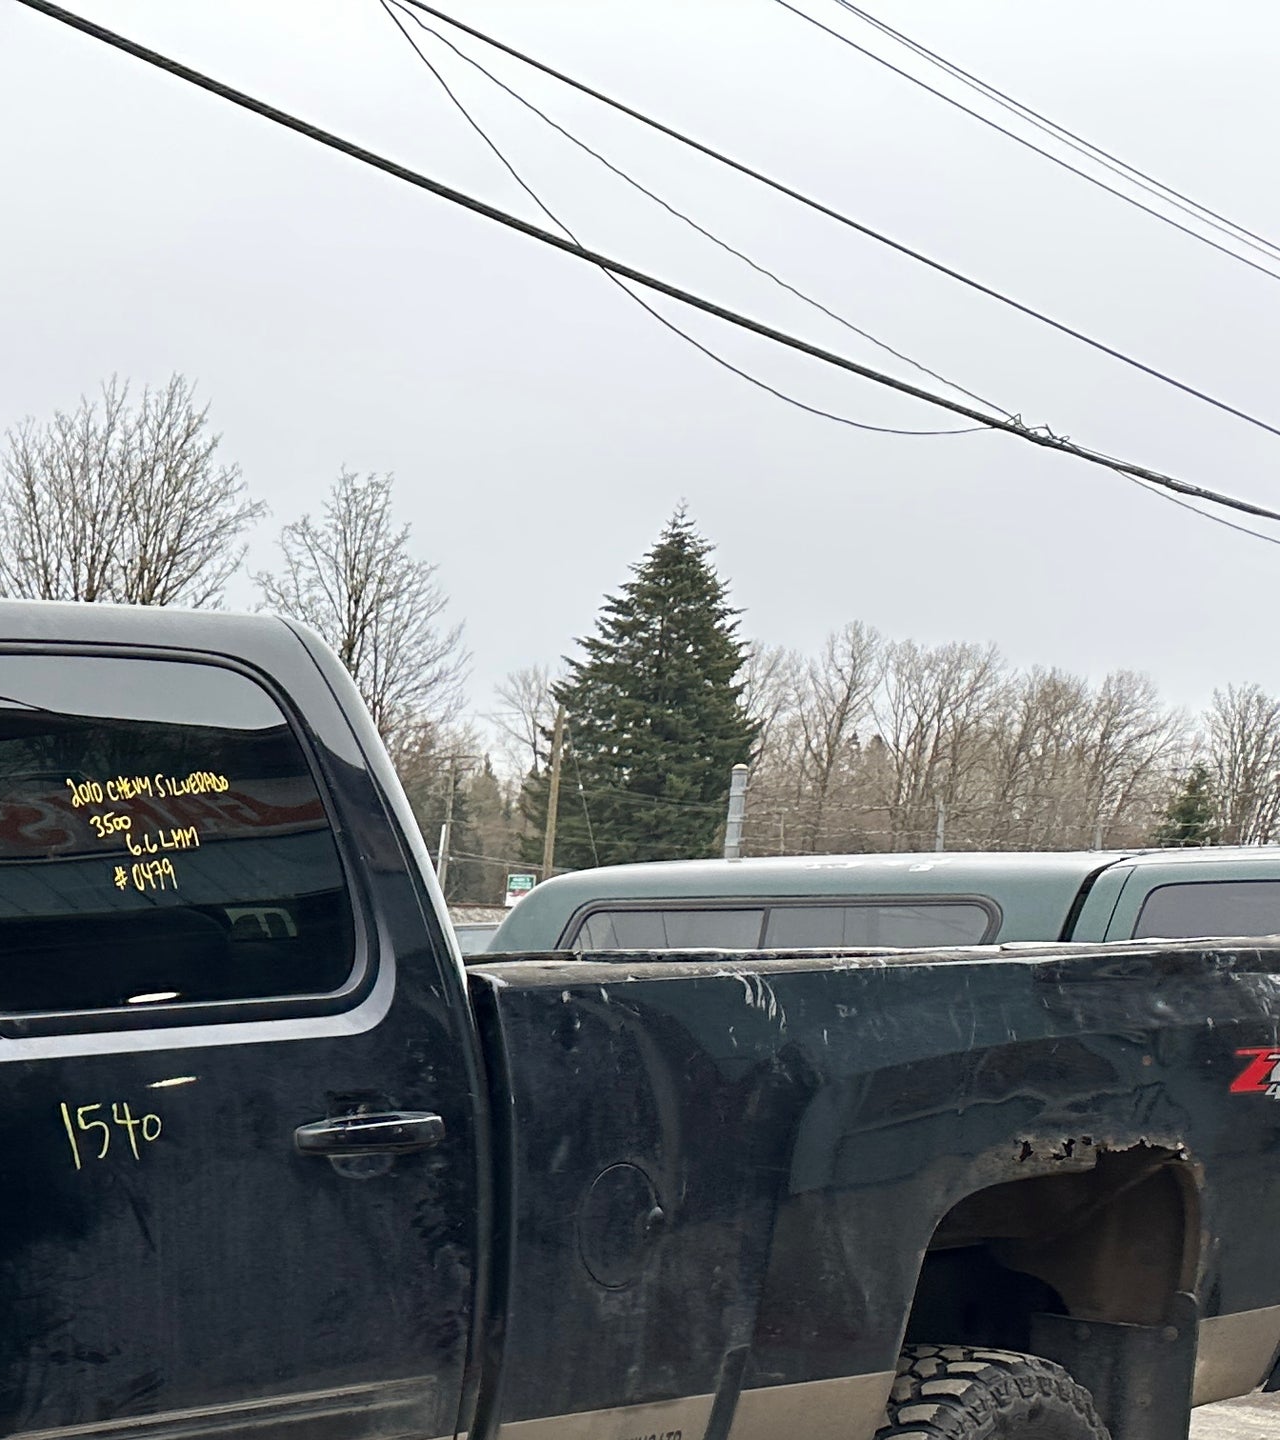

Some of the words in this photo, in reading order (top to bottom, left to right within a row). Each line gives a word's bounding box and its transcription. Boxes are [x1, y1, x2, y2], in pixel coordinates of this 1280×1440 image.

[66, 778, 104, 808] 2010
[106, 775, 153, 802] CHEVY
[89, 811, 131, 838] 3500
[158, 826, 200, 849] LMM
[60, 1102, 162, 1170] 1540
